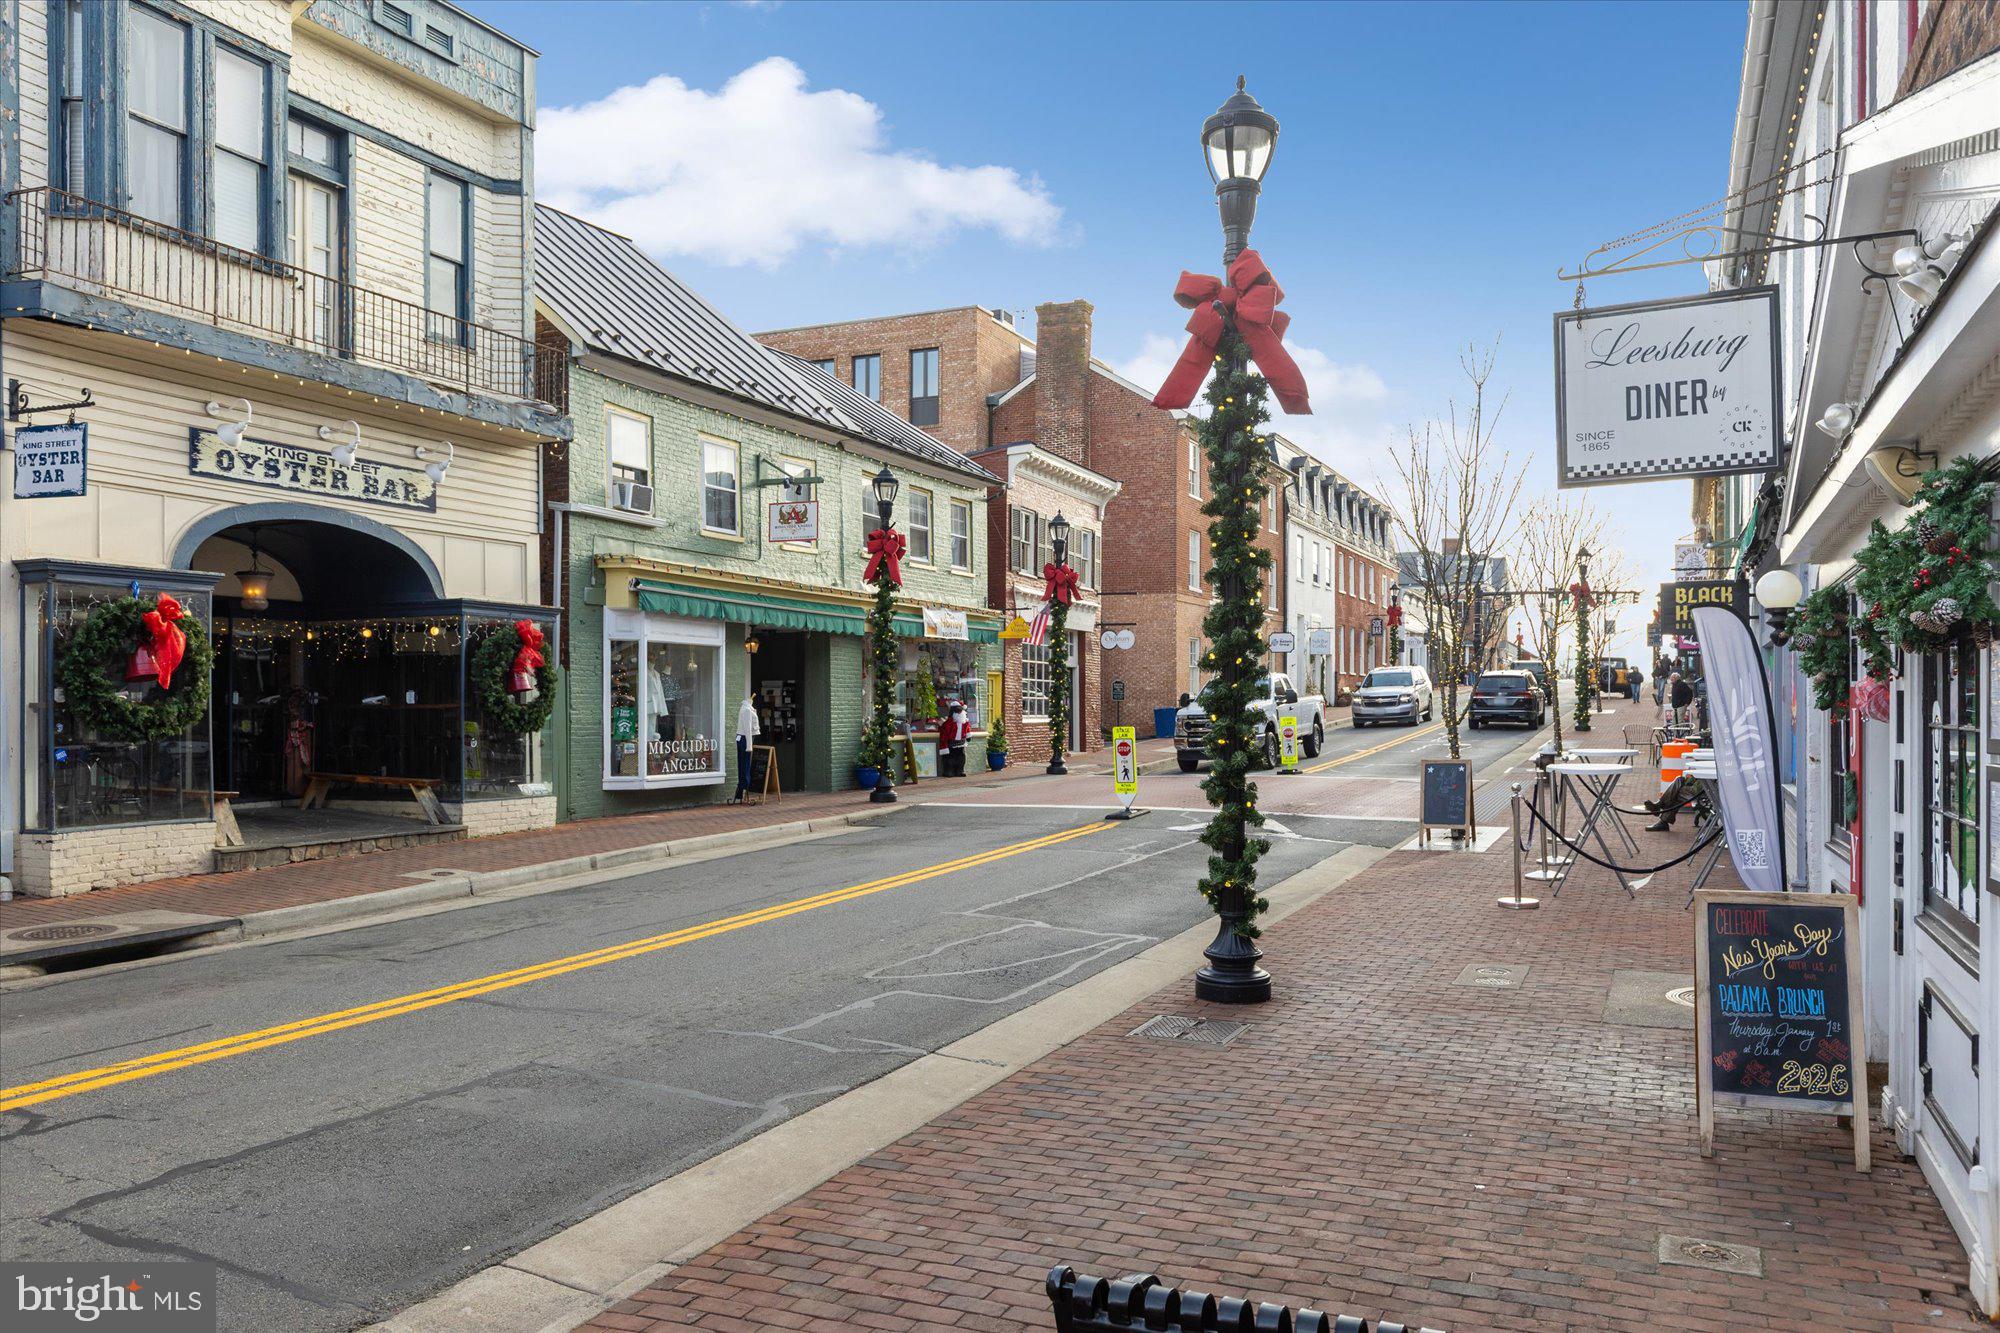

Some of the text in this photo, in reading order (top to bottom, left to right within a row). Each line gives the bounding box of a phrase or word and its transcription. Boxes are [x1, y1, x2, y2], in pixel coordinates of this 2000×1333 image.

[1584, 322, 1750, 373] Leesburg
[1625, 378, 1726, 422] DINER by
[22, 440, 77, 449] KING STREET
[1575, 430, 1616, 442] SINCE
[264, 445, 308, 463] KING
[1581, 441, 1610, 452] 1865
[18, 451, 80, 467] OYSTER
[32, 469, 64, 484] BAR
[215, 449, 420, 502] OYSTER BAR
[1675, 586, 1733, 606] BLACK
[648, 738, 718, 755] MISGUIDED
[661, 757, 707, 773] ANGELS
[1715, 907, 1769, 936] CELEBRATE
[1722, 923, 1832, 980] New Year's Day
[1718, 984, 1826, 1015] PAJAMA BRUNCH
[1775, 1022, 1815, 1052] January
[1826, 1020, 1842, 1037] 1st
[1776, 1060, 1849, 1096] 2026
